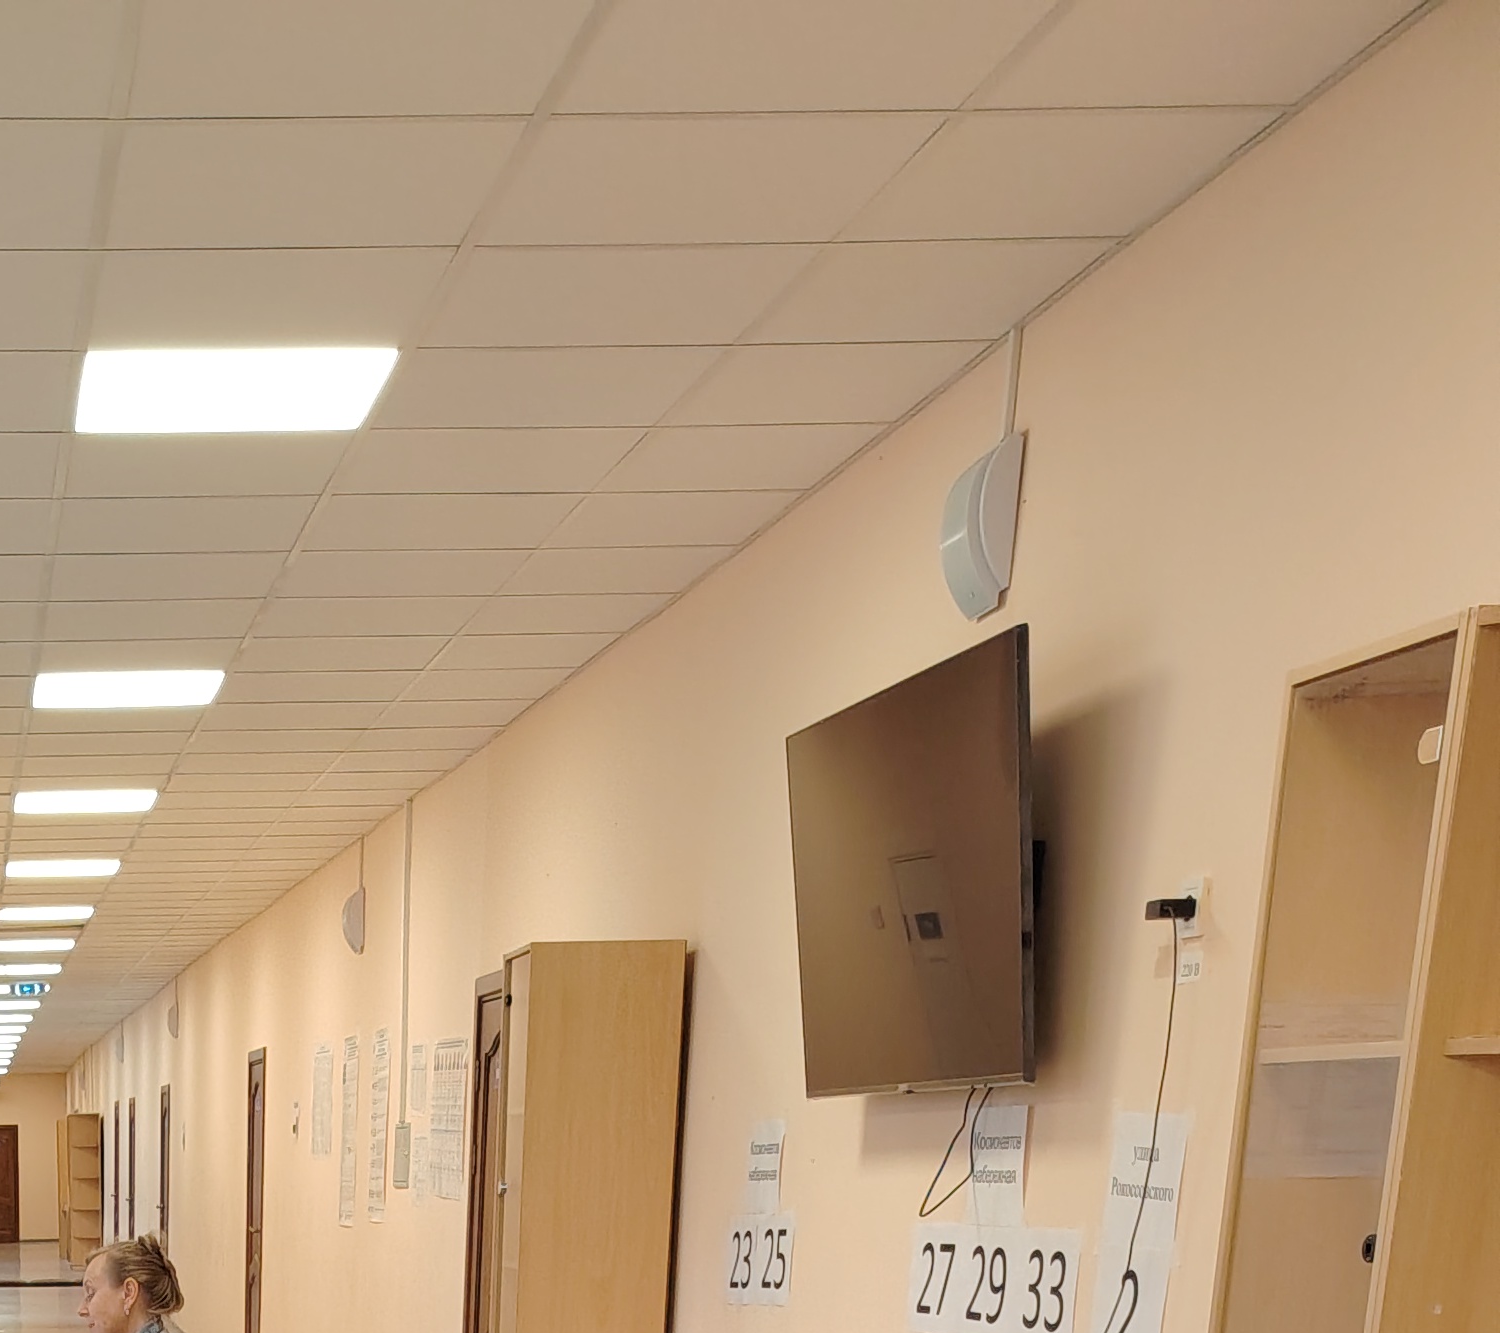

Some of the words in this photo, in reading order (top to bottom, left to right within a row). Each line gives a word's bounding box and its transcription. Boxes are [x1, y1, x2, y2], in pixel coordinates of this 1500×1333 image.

[729, 1230, 752, 1289] 23
[761, 1228, 787, 1290] 25
[916, 1242, 956, 1316] 27
[966, 1245, 1007, 1324] 29
[1022, 1249, 1067, 1332] 33
